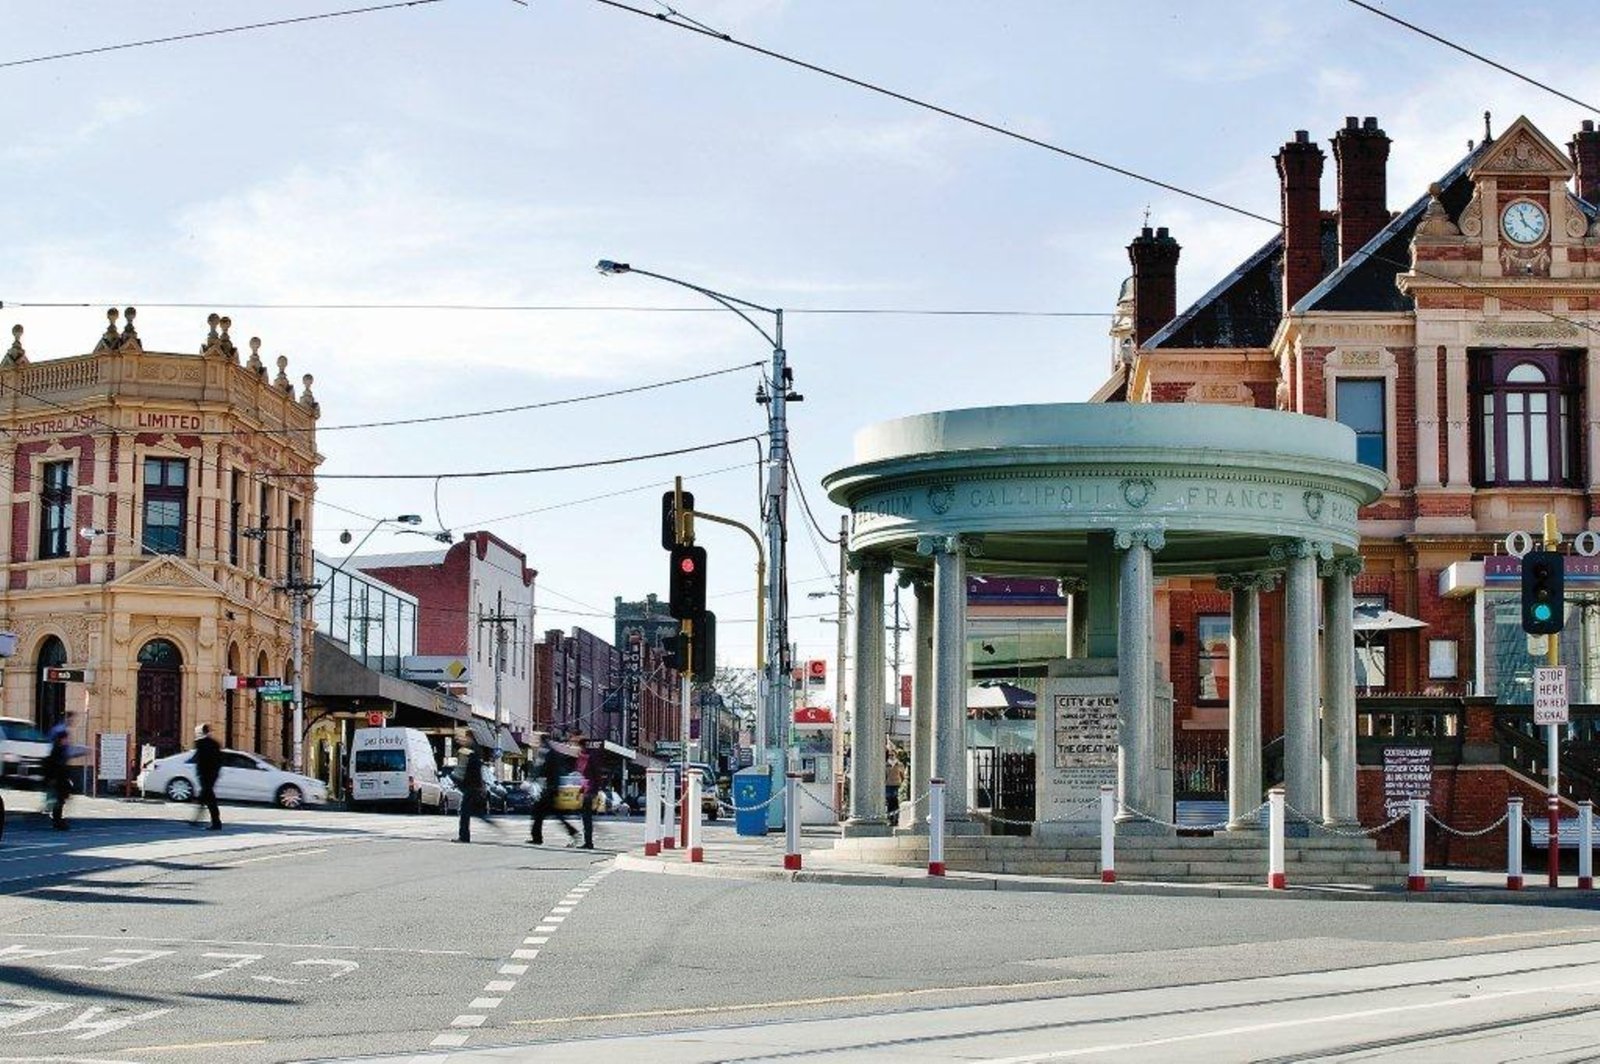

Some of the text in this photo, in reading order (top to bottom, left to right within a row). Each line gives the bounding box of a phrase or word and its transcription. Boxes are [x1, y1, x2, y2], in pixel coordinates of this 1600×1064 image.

[17, 413, 97, 438] AUSTRALASIA
[138, 412, 200, 431] LIMITED
[970, 484, 1101, 508] GALLIPOLI
[1186, 487, 1284, 511] FRANCE
[1539, 670, 1563, 681] STOP
[1539, 684, 1565, 695] HERE
[1059, 697, 1085, 706] CITY
[1536, 697, 1567, 708] ON RED
[1536, 710, 1566, 720] SIGNAL
[1057, 744, 1075, 754] THE
[1076, 744, 1104, 754] GREAT
[1409, 764, 1431, 772] OPEN
